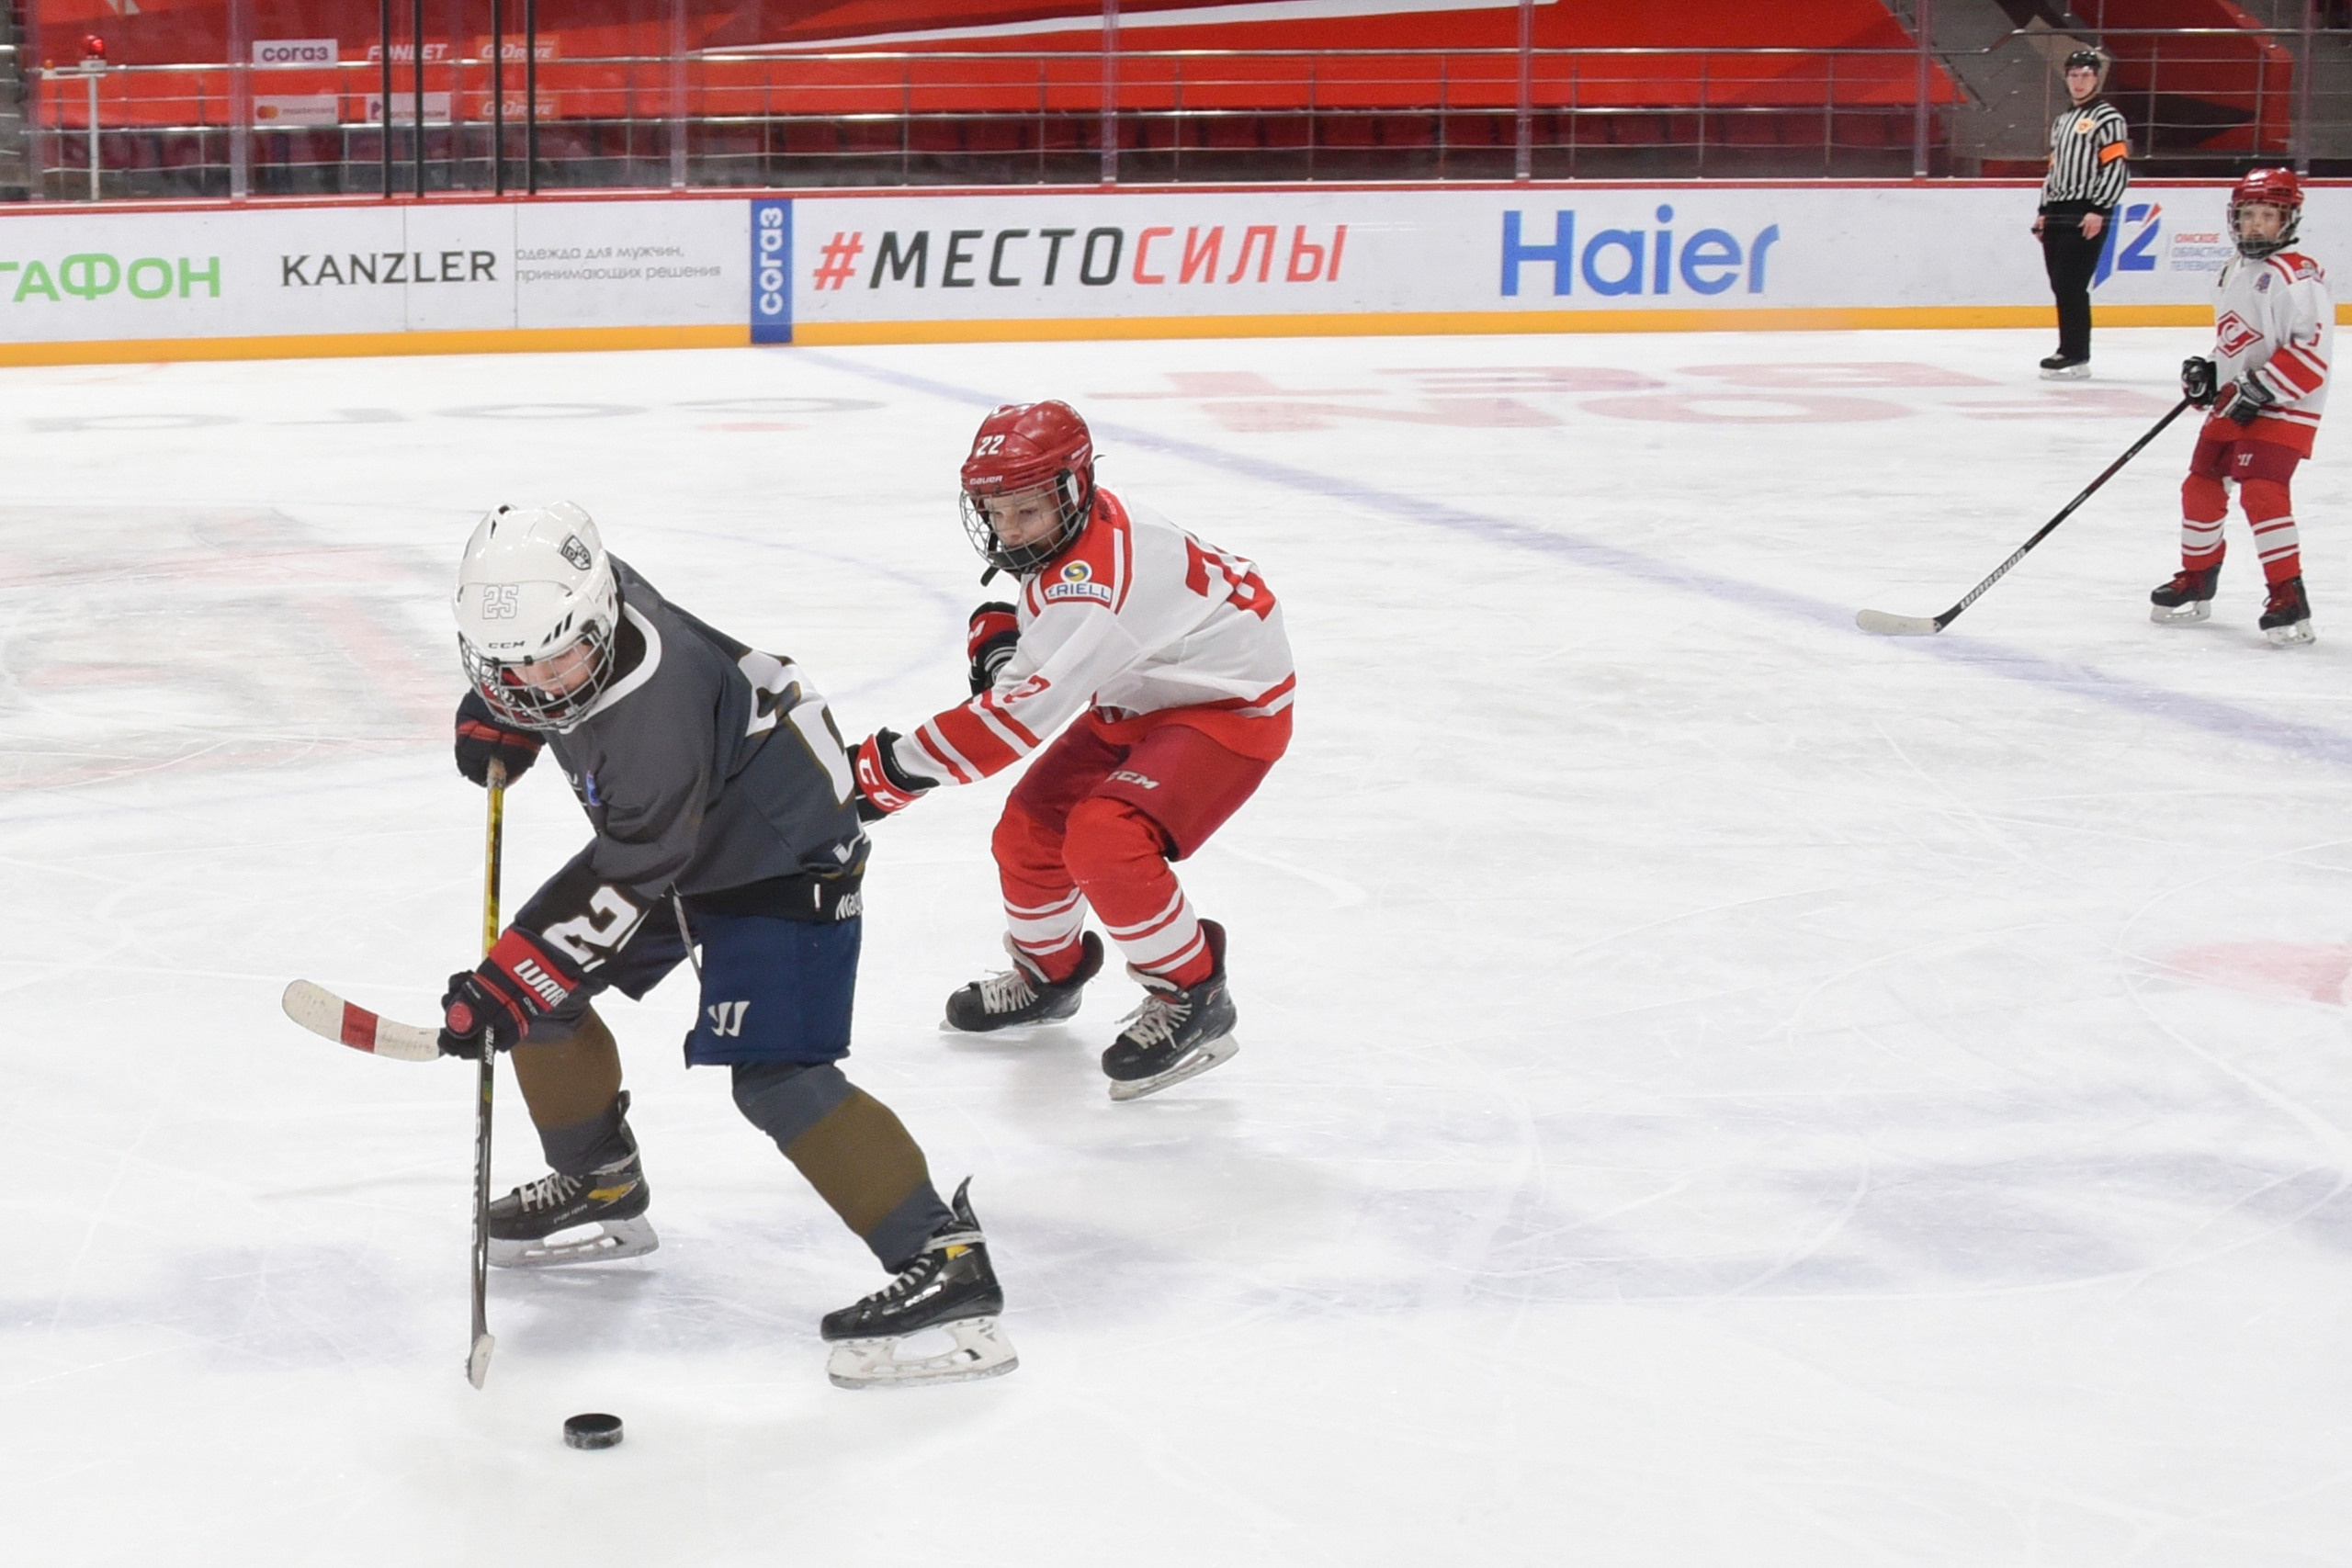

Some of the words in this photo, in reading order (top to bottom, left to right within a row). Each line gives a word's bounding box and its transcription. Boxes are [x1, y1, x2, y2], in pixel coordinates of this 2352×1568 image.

[368, 44, 448, 61] FNET
[515, 247, 581, 261] одежда
[584, 246, 612, 259] для
[760, 207, 784, 315] согаз
[813, 224, 1348, 290] #МЕСТОСИЛЫ
[1501, 204, 1779, 297] Haier
[281, 250, 497, 287] KANZLER
[515, 267, 641, 283] принимающих
[646, 265, 721, 280] решения
[976, 434, 1006, 457] 22
[969, 475, 1003, 486] BAUER
[482, 584, 518, 620] 25
[488, 640, 526, 649] CCM
